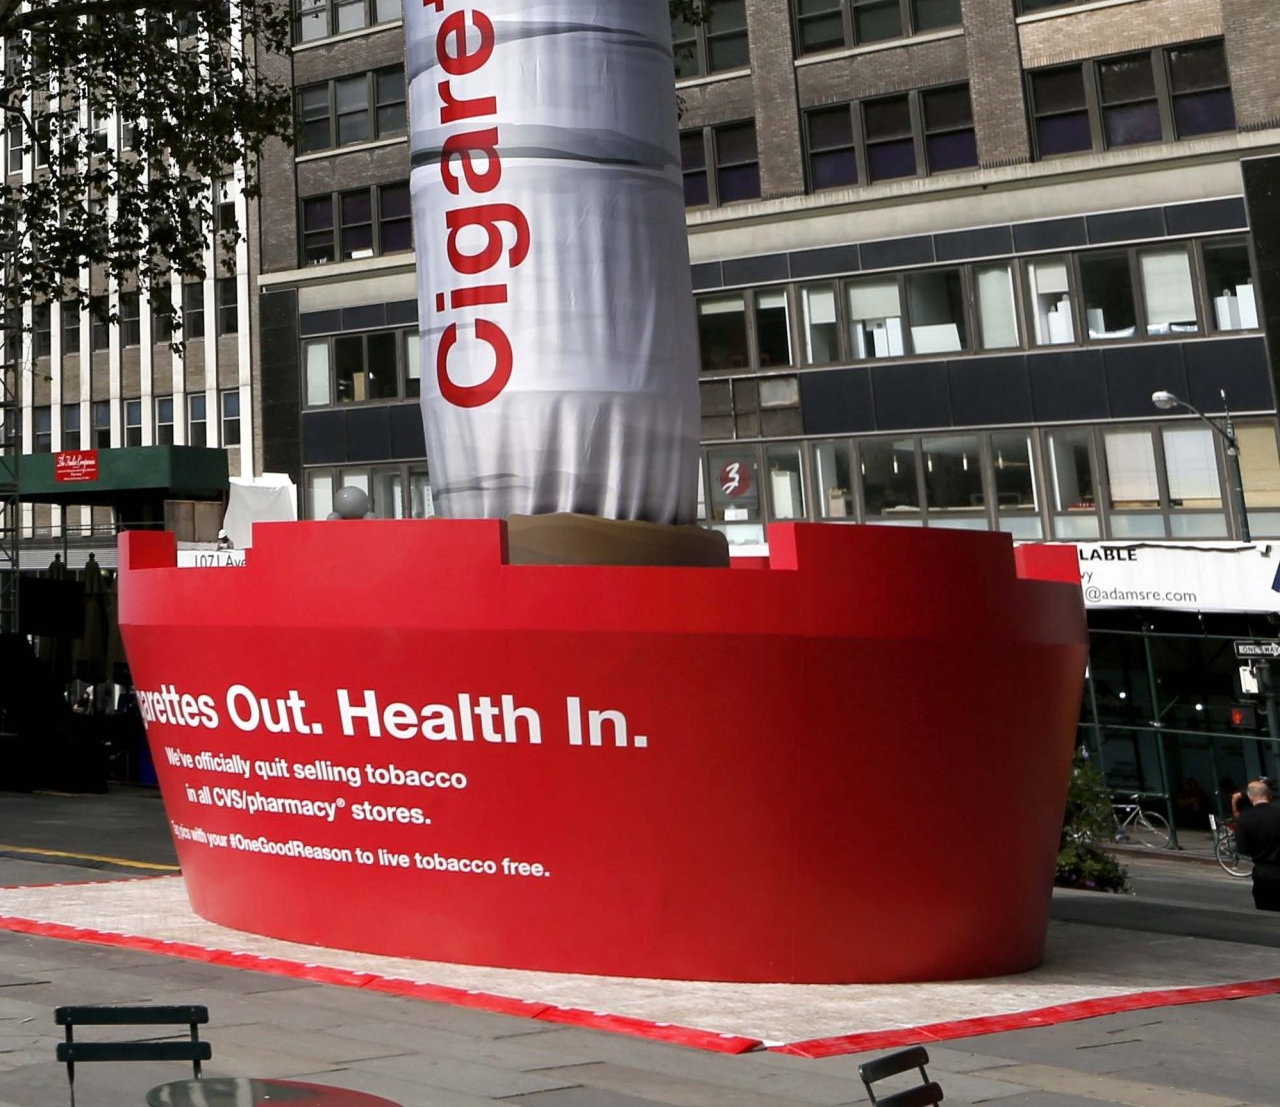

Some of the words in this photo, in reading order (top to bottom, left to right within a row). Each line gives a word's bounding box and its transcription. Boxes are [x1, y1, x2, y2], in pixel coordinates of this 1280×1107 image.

[1079, 548, 1138, 562] LABLE
[226, 684, 324, 735] Out.
[336, 689, 542, 744] Health
[566, 696, 648, 748] In.
[164, 746, 194, 768] We've
[194, 751, 251, 779] officially
[255, 757, 290, 780] quit
[293, 760, 362, 788] selling
[365, 764, 468, 789] tobacco
[184, 783, 198, 803] in
[198, 785, 213, 805] all
[351, 801, 432, 825] stores.
[229, 833, 352, 863] #OneGoodReason
[355, 847, 375, 866] to
[377, 848, 410, 869] live
[414, 852, 497, 875] tobacco
[501, 857, 551, 877] free.
